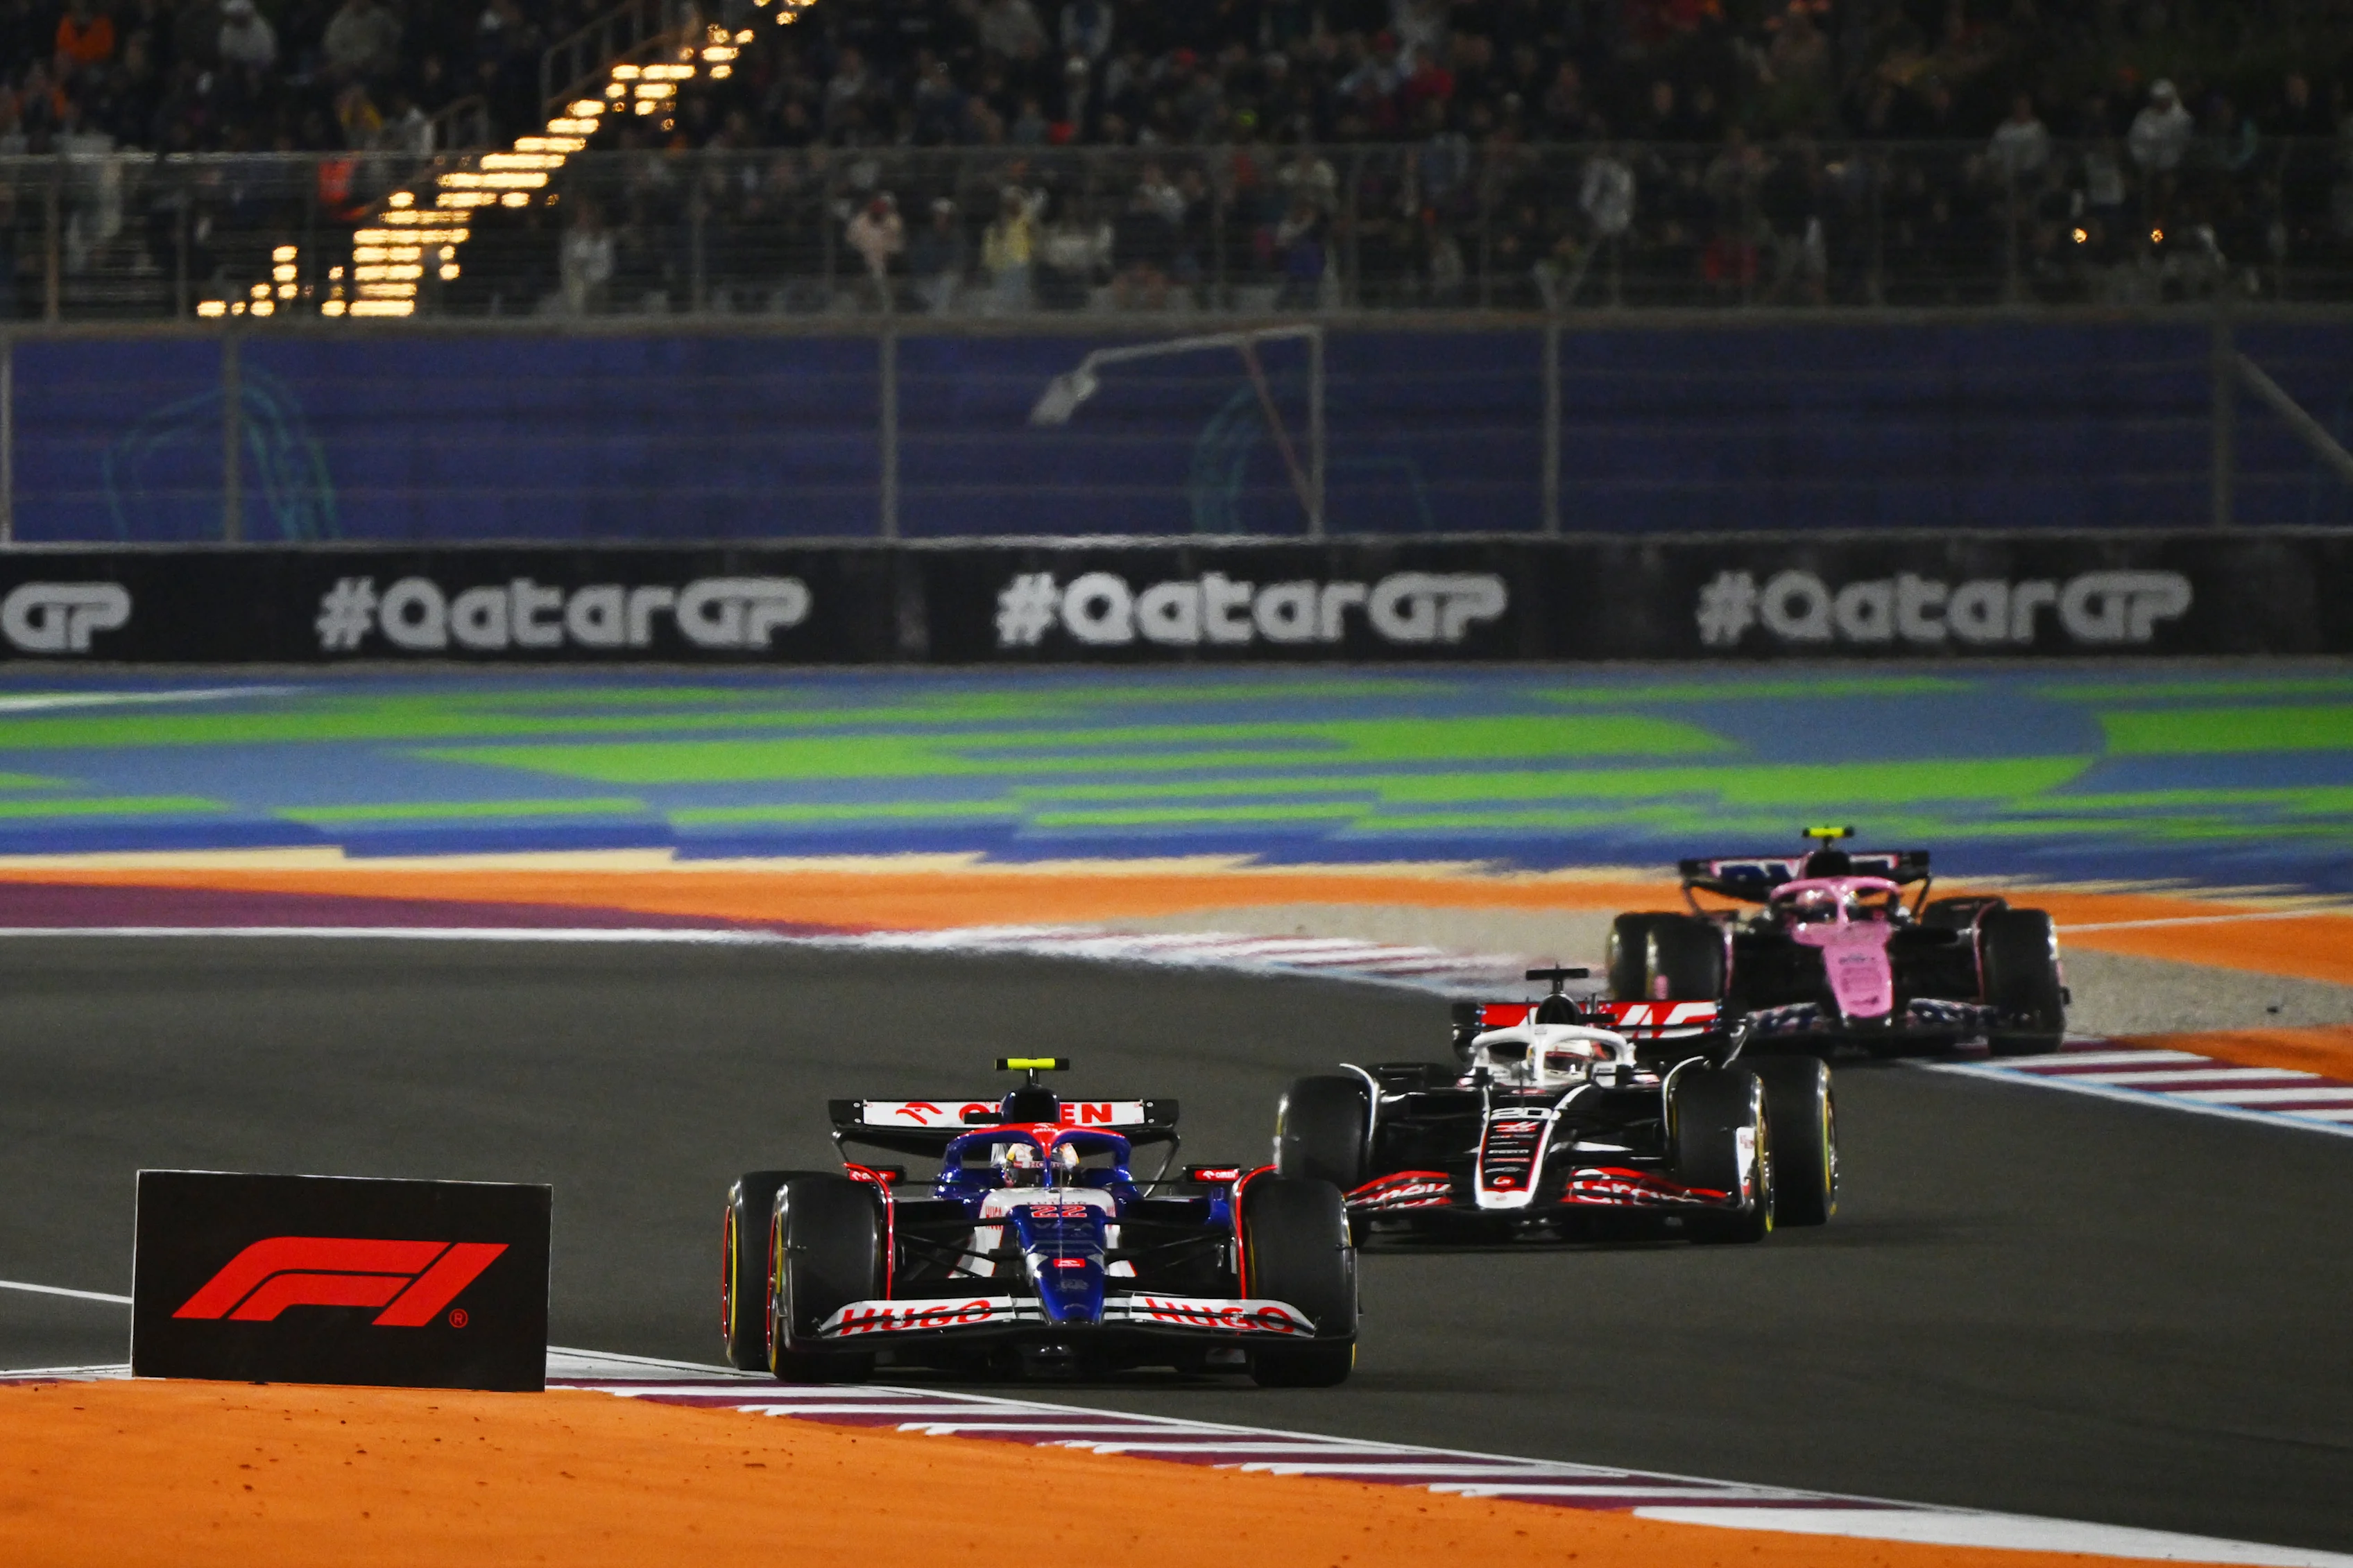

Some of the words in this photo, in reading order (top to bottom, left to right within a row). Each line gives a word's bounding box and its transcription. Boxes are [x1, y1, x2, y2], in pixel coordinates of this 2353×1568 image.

[315, 576, 811, 650] #QatarGP
[995, 571, 1506, 646] #QatarGP
[1695, 569, 2193, 645] #QatarGP
[959, 1103, 1113, 1123] OEN
[1029, 1205, 1088, 1218] 22
[171, 1237, 511, 1327] F1
[839, 1299, 993, 1336] HUGO
[1145, 1297, 1294, 1334] HUGO
